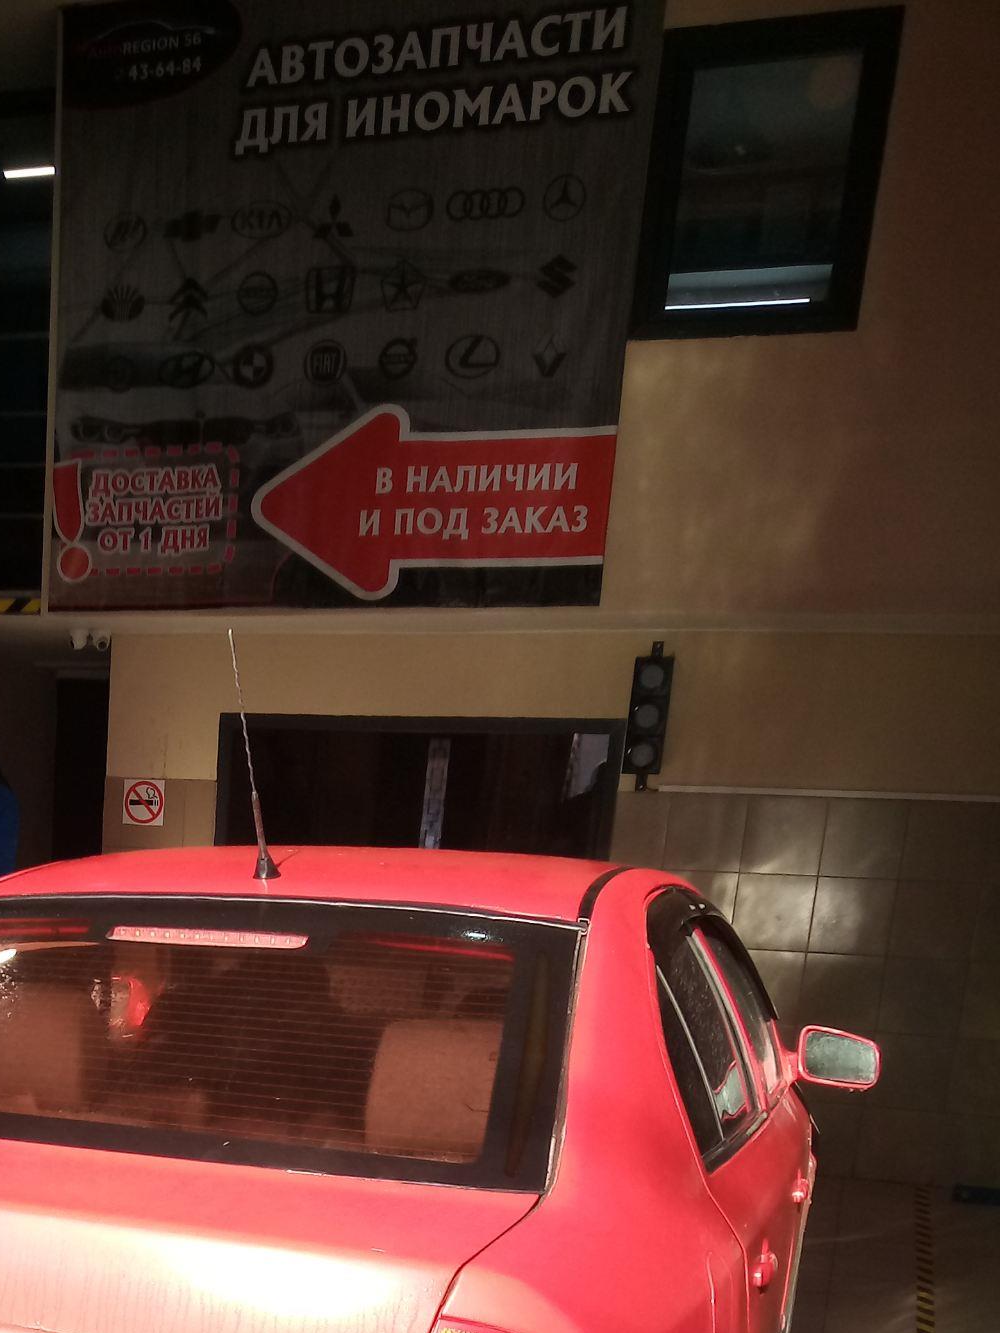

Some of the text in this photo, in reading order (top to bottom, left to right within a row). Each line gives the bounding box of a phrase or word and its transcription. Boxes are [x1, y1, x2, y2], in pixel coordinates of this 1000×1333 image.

[246, 6, 629, 88] АВТОЗАПЧАСТИ
[127, 56, 203, 82] 43-64-84
[234, 71, 633, 157] ДЛЯ ИНОМАРОК
[90, 464, 221, 499] ДОСТАВКА
[375, 462, 579, 495] В НАЛИЧИИ
[87, 493, 222, 526] ЗАПЧАСТЕЙ
[359, 504, 589, 541] И ПОД ЗАКАЗ
[98, 523, 210, 556] ОТ 1 ДНЯ
